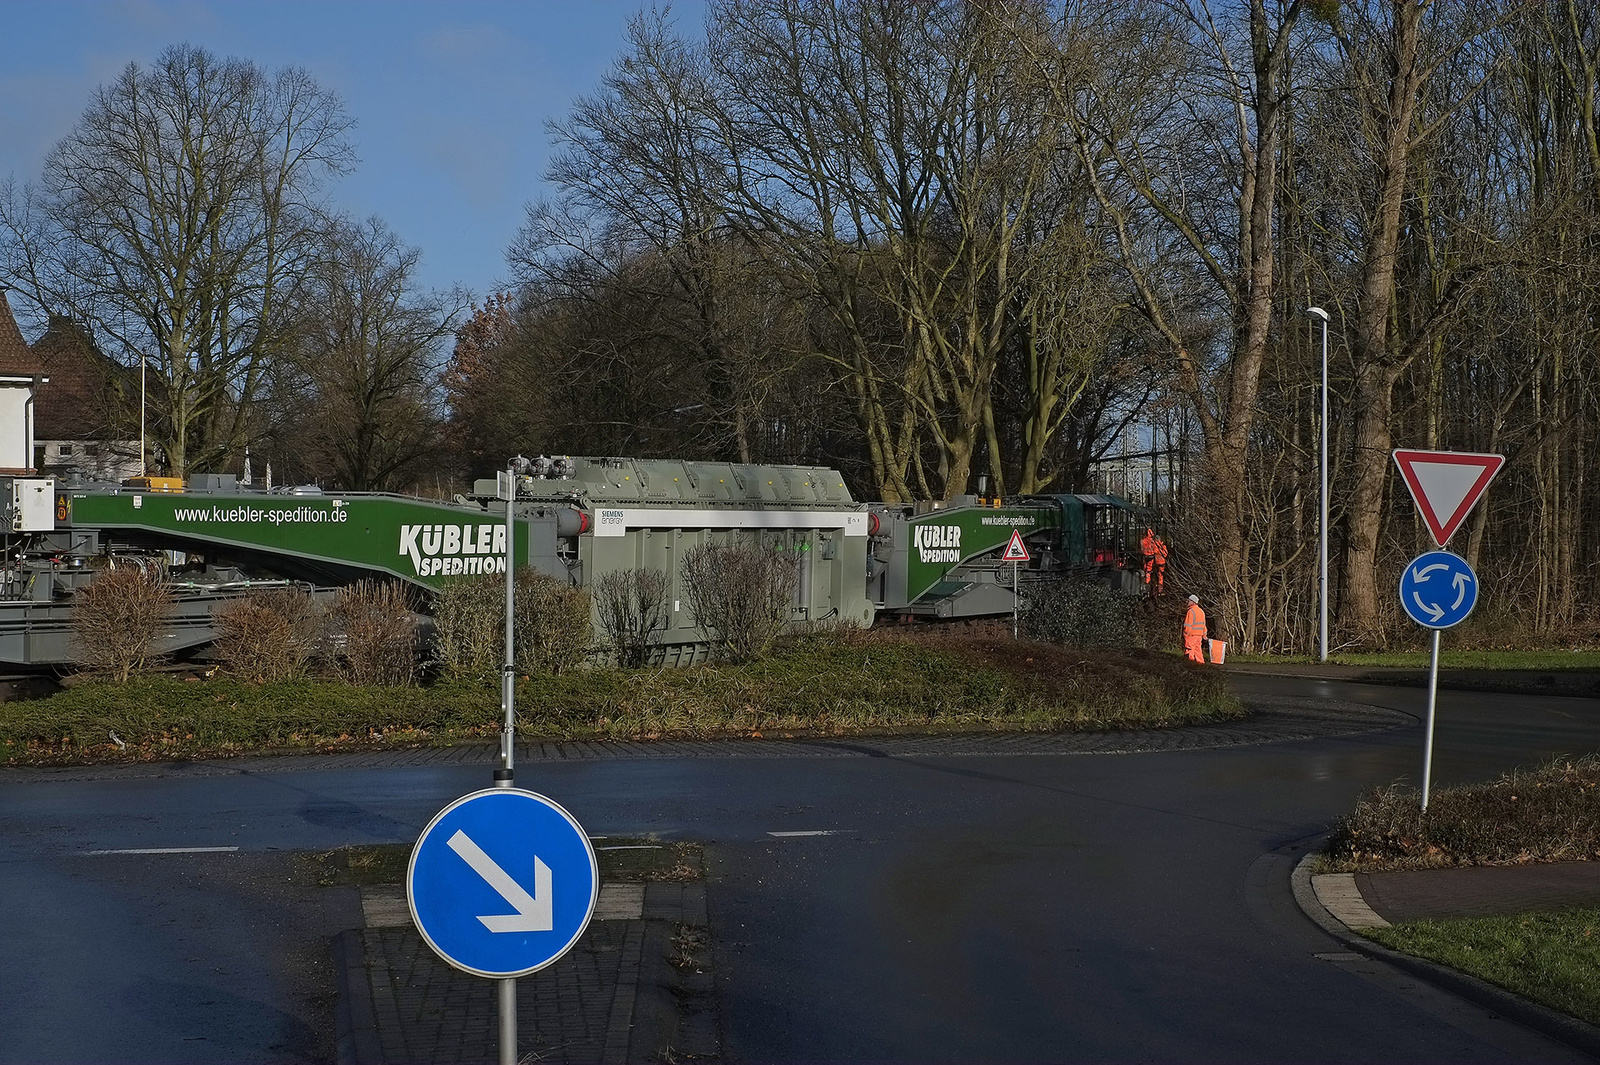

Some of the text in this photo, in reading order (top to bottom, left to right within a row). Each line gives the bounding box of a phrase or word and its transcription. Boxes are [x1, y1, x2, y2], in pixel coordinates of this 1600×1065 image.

[174, 505, 348, 526] www.kuebler-spedition.de
[601, 510, 624, 518] SIEMENS
[601, 517, 624, 525] energy
[981, 514, 1036, 528] www.kuebler-spedition.de
[399, 525, 507, 576] KÜBLER
[913, 525, 962, 562] KÜBLER
[922, 549, 961, 563] SPEDITION
[420, 556, 507, 577] SPEDITION
